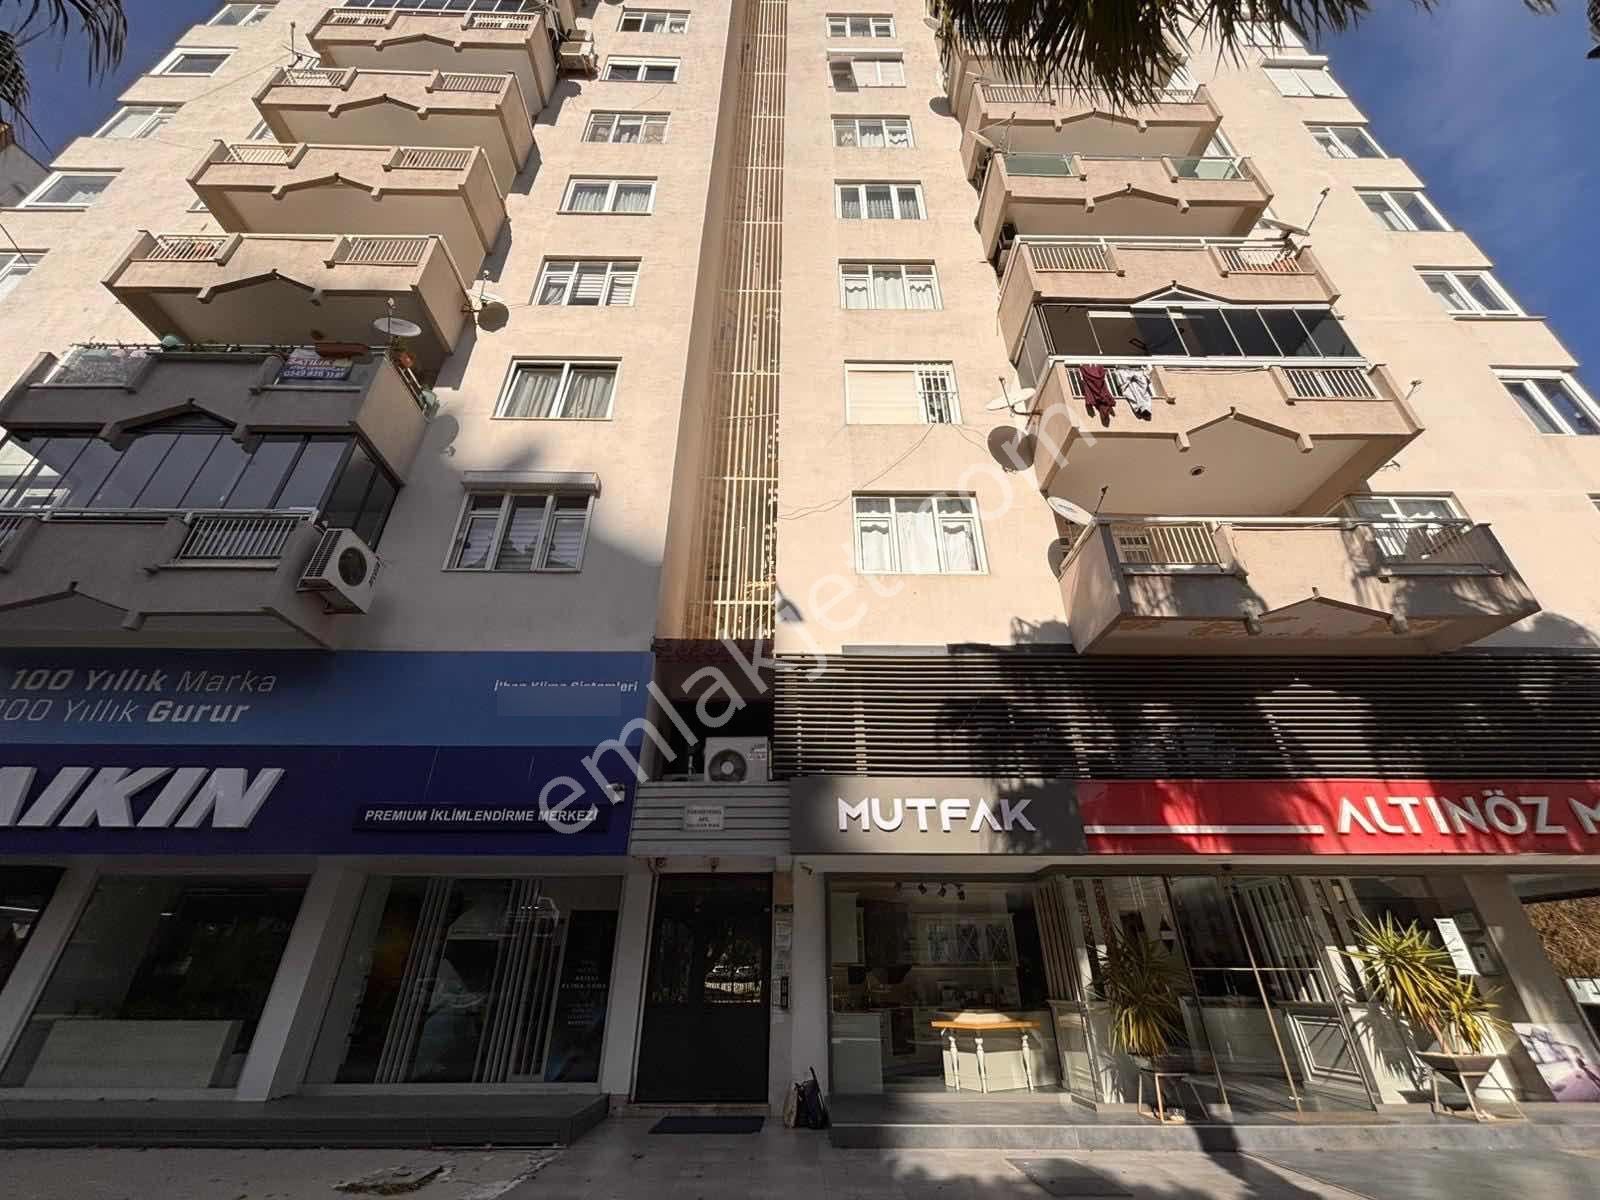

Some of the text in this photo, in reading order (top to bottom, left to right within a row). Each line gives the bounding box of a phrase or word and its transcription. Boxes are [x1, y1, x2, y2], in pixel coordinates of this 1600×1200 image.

[11, 669, 75, 690] 100
[176, 670, 276, 692] Marka
[147, 700, 249, 722] Gurur
[364, 809, 427, 822] PREMIUM
[430, 808, 533, 822] İKLİMLENDİRME
[837, 797, 1037, 833] MUTFAK
[1337, 789, 1567, 835] ALTINÖZ
